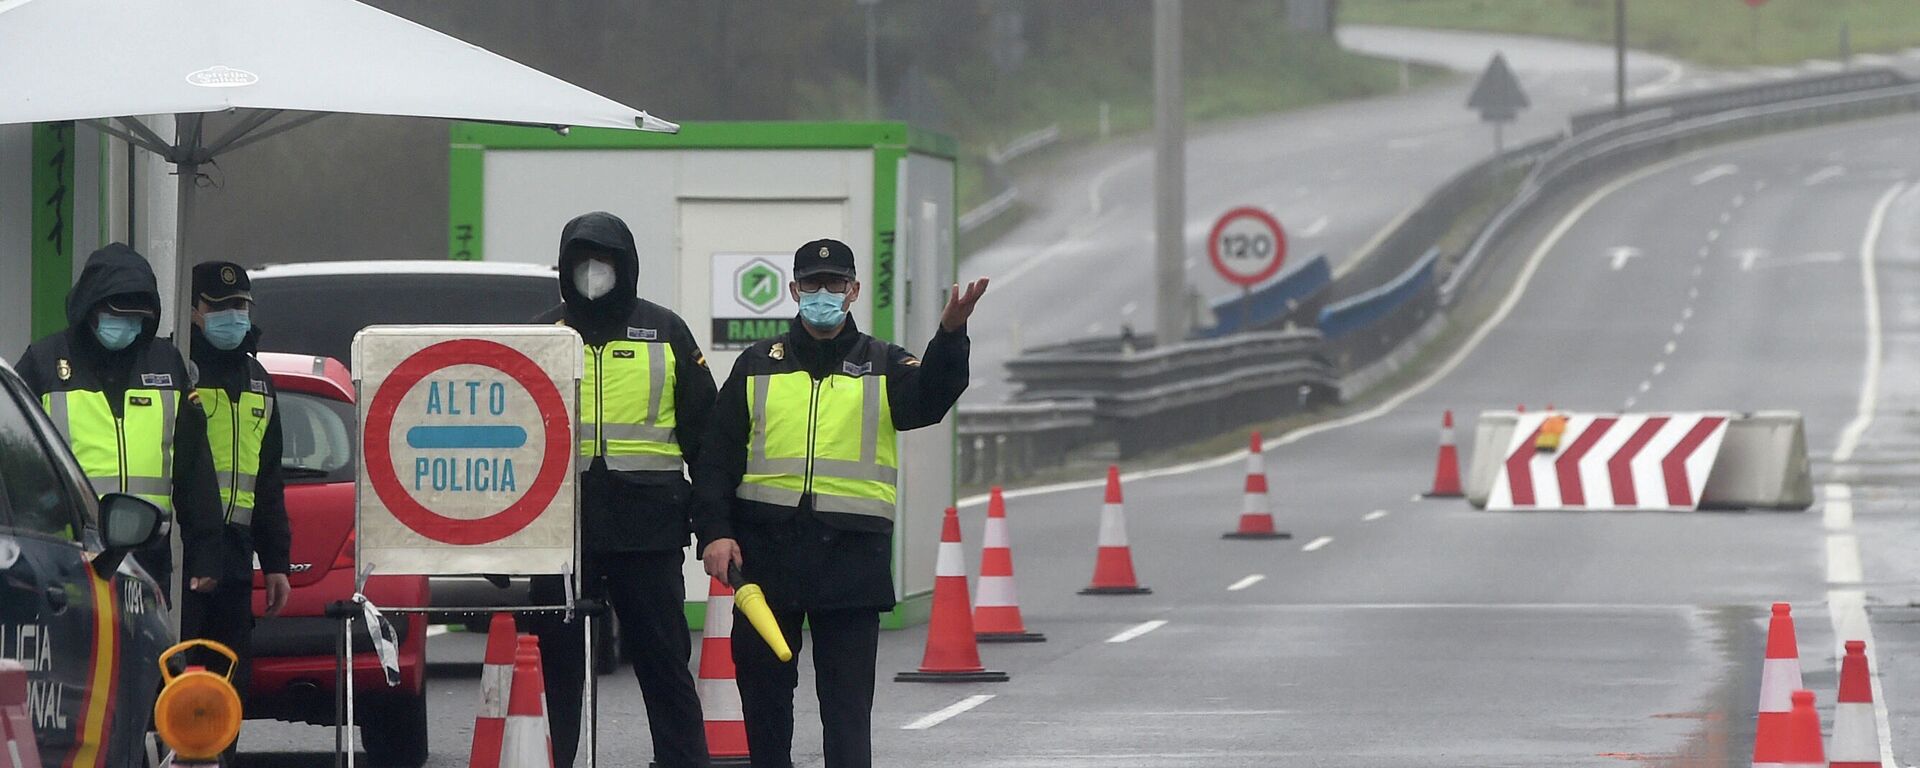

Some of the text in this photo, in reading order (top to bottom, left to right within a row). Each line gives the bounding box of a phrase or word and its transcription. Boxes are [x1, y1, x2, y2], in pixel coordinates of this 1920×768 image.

[1223, 234, 1271, 258] 120
[427, 381, 505, 415] ALTO
[415, 457, 516, 492] POLICIA
[27, 681, 67, 728] NAL
